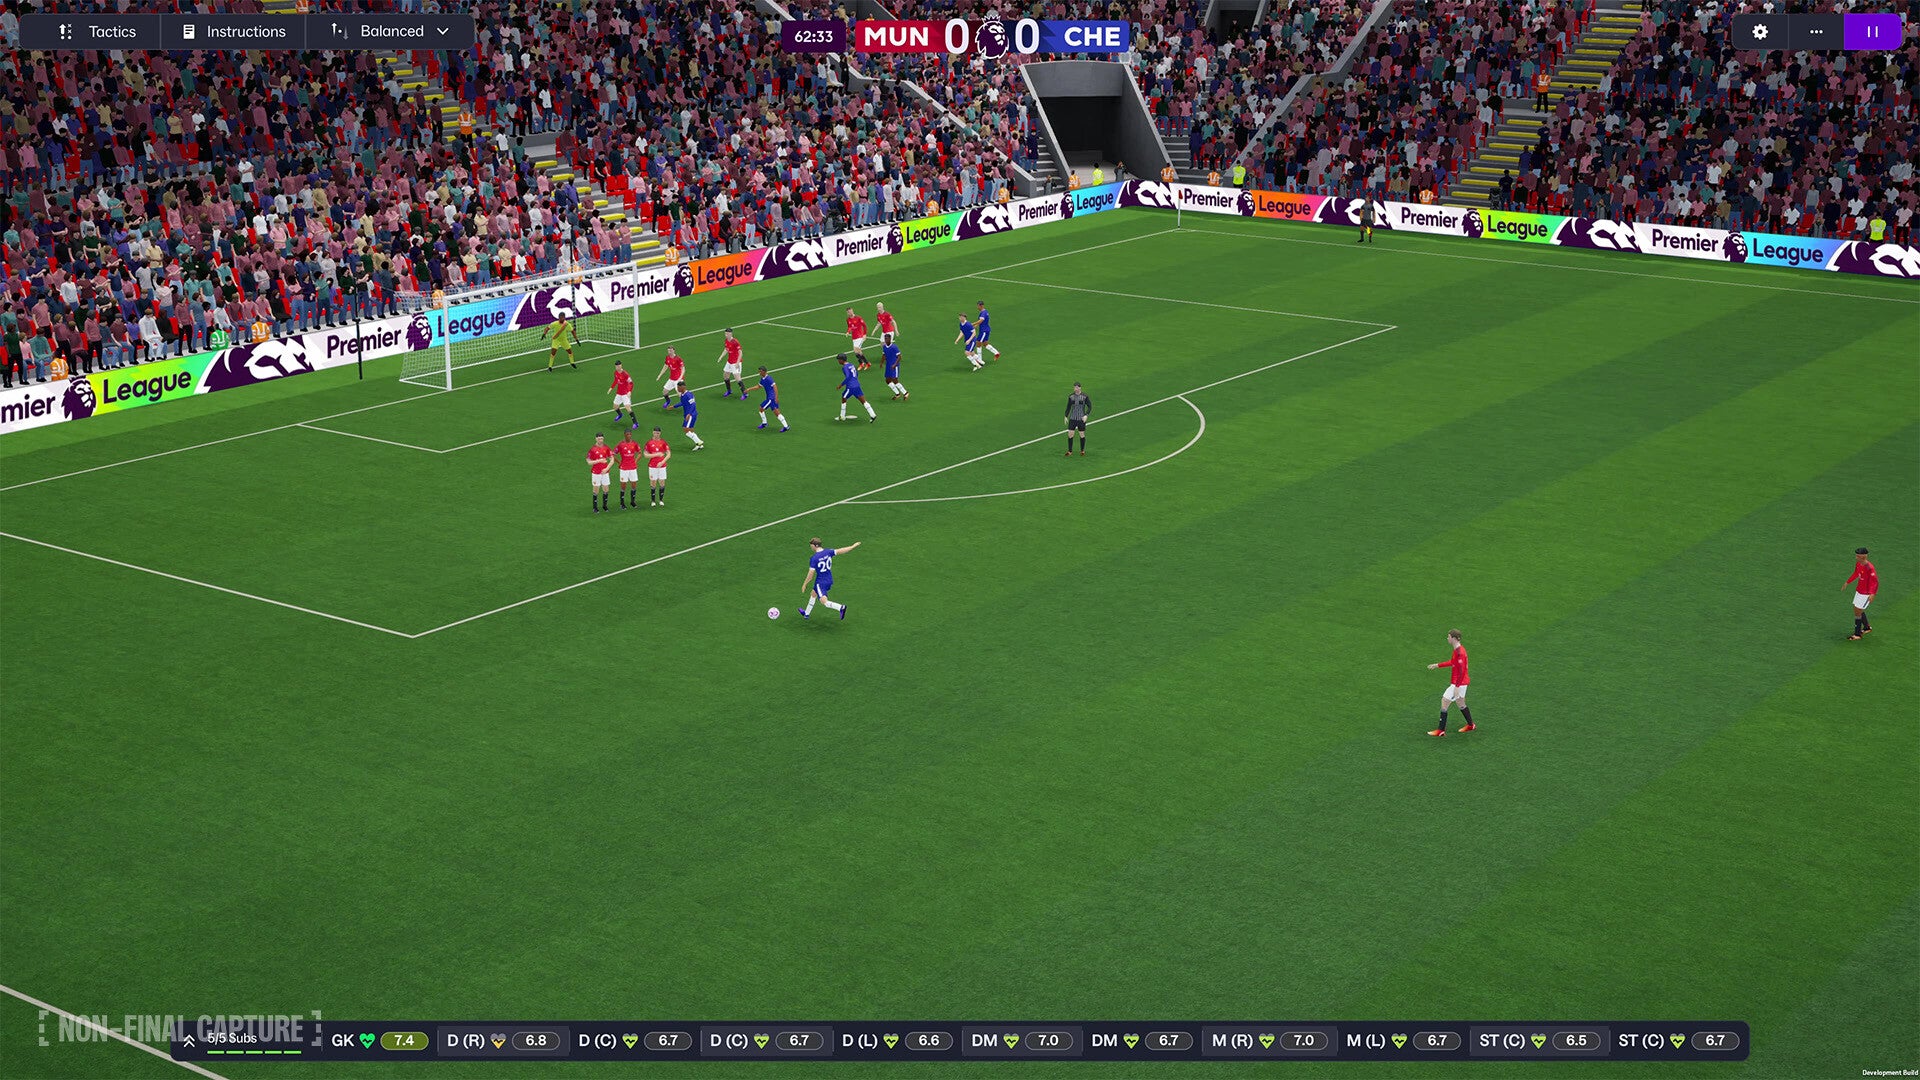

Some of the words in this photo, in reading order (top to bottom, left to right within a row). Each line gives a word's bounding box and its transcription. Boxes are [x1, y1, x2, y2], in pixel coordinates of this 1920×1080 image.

[1018, 200, 1058, 221] Premier
[1076, 192, 1114, 212] League
[1184, 188, 1234, 208] Premier
[1258, 195, 1311, 219] League
[836, 233, 884, 257] Premier
[906, 223, 951, 245] League
[1401, 206, 1458, 229] Premier
[1487, 214, 1548, 240] League
[1652, 228, 1719, 252] Premier
[1753, 238, 1824, 266] League
[610, 275, 670, 302] Premier
[697, 262, 753, 285] League
[326, 326, 402, 359] Premier
[437, 308, 506, 337] League
[103, 371, 192, 402] League
[817, 556, 833, 573] 20
